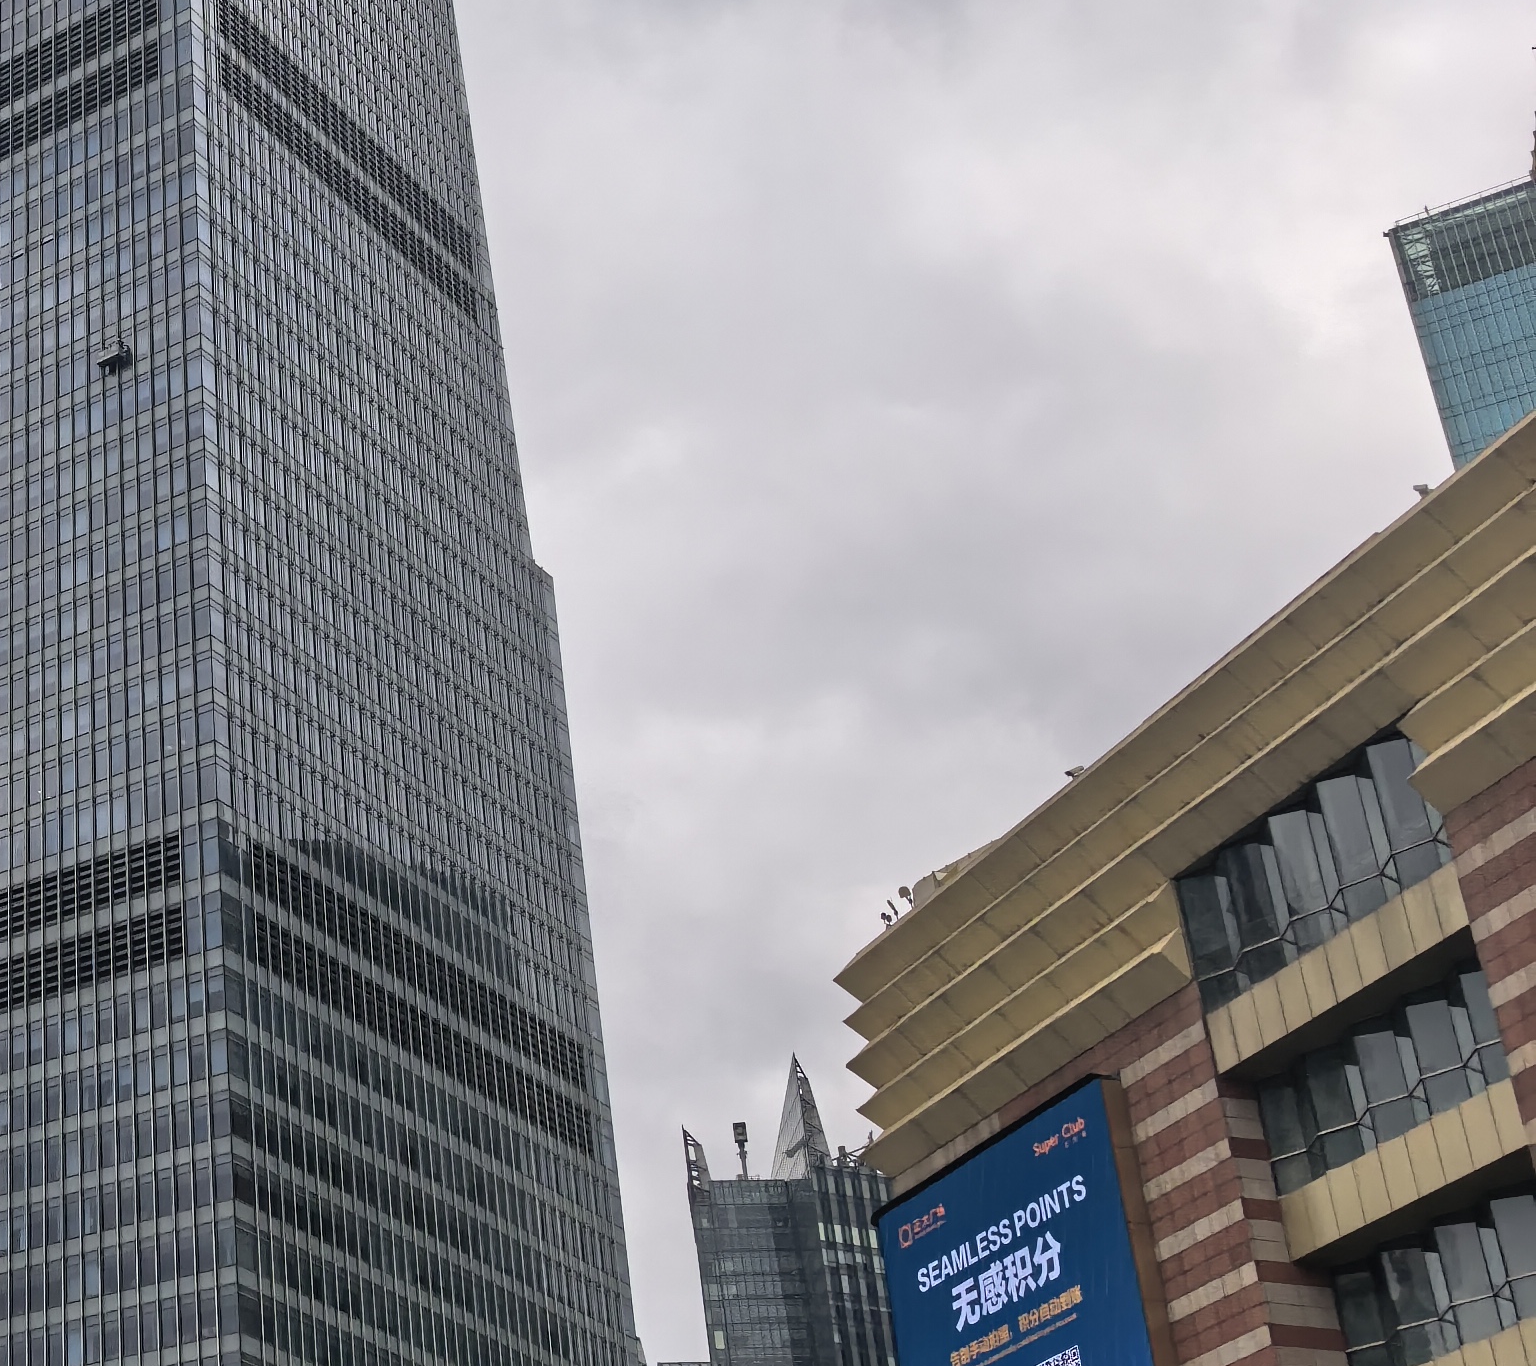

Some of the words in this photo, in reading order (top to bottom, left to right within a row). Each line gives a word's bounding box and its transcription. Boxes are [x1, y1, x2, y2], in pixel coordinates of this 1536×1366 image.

[1033, 1133, 1060, 1156] Super
[1062, 1117, 1085, 1139] Club
[917, 1218, 1012, 1292] SEAMLESS
[1013, 1175, 1086, 1237] POINTS
[951, 1231, 1061, 1332] 无感积分
